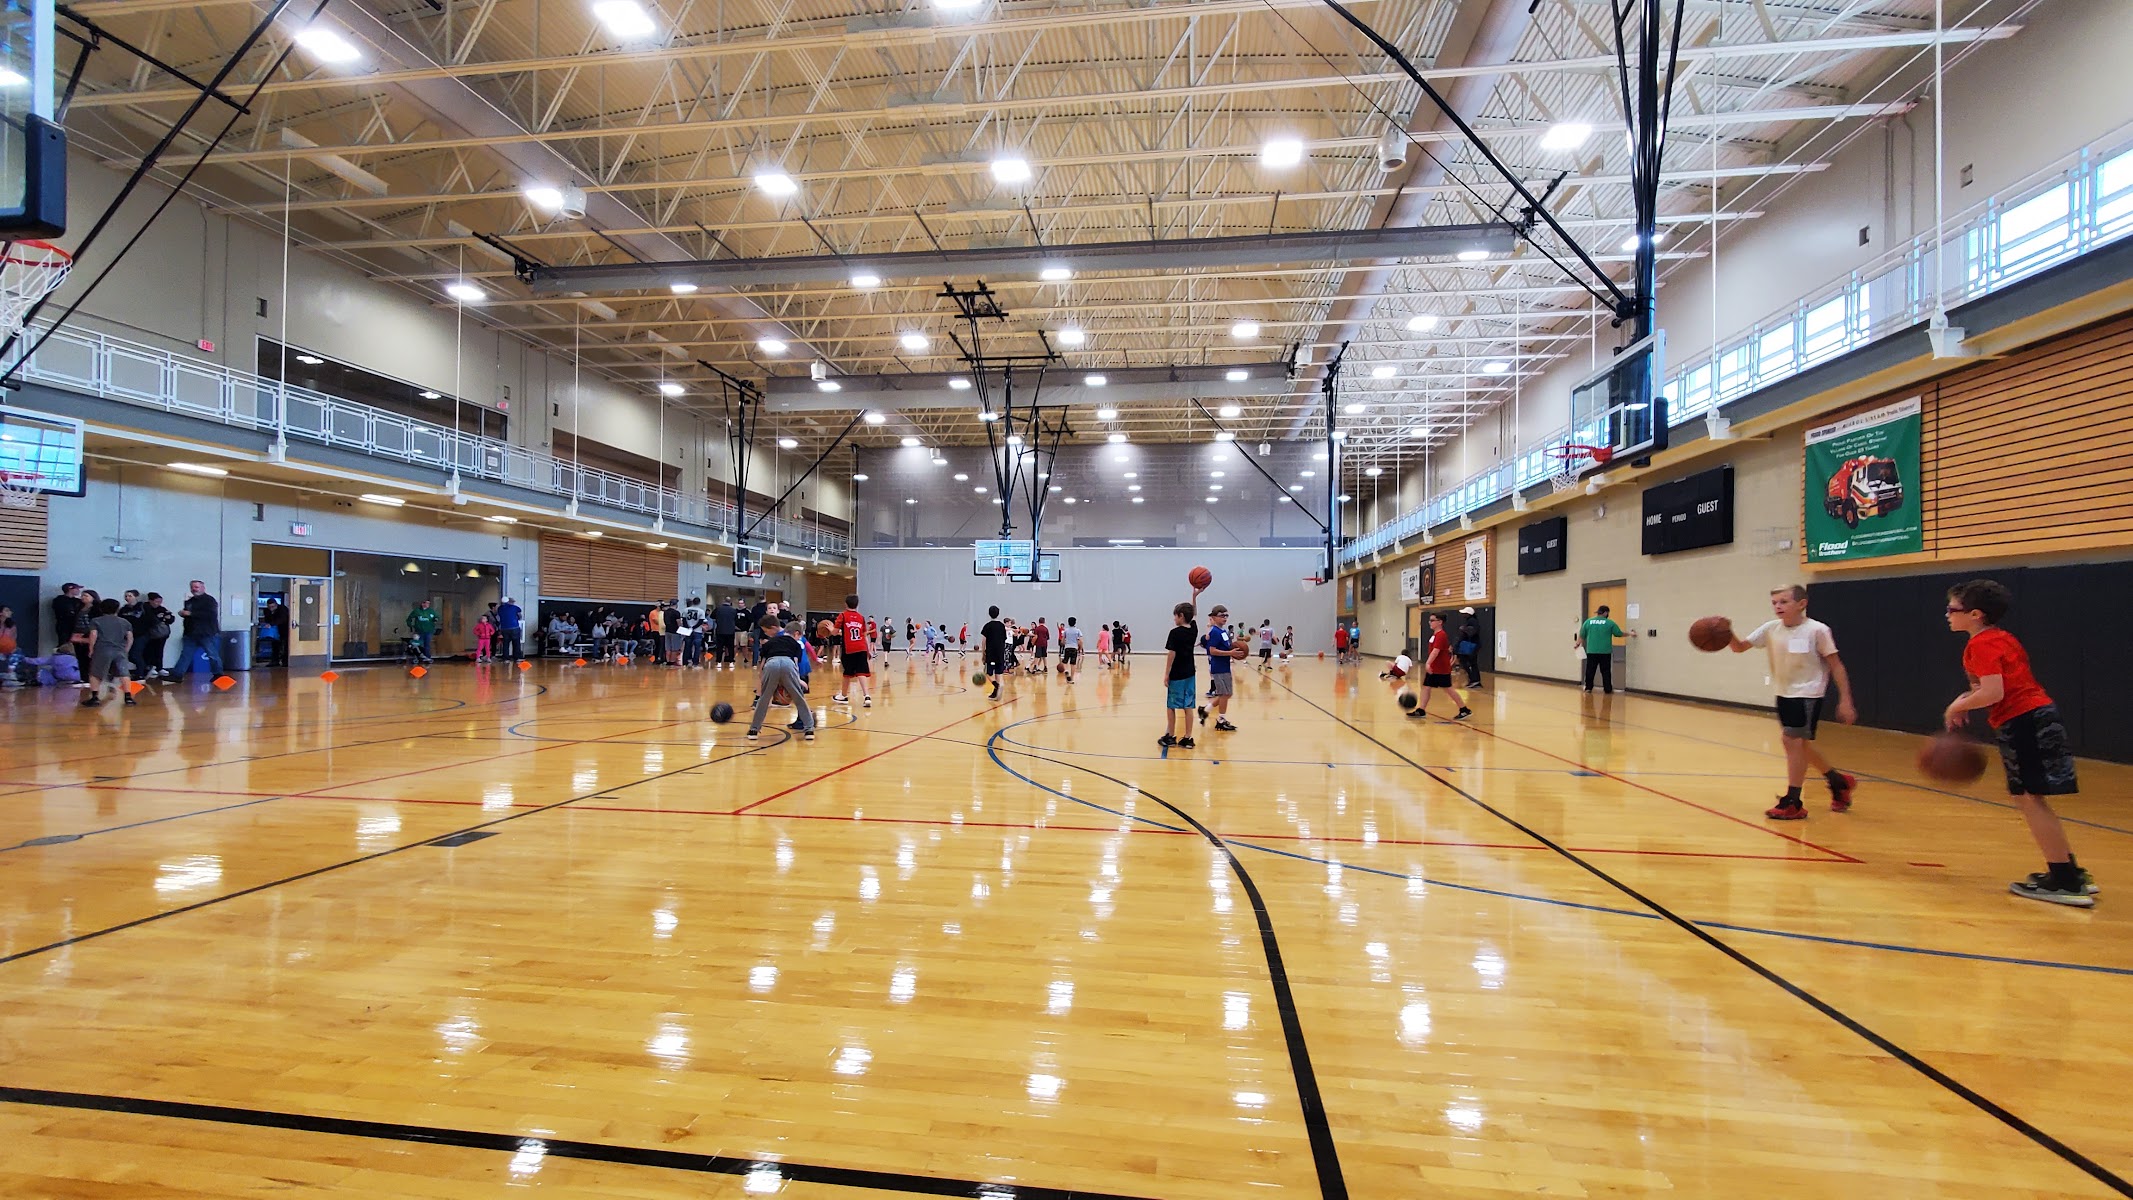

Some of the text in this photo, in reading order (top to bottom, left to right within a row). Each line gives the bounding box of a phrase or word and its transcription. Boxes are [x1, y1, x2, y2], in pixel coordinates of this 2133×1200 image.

[1646, 513, 1662, 526] HOME
[1697, 500, 1719, 515] GUEST
[1819, 540, 1848, 551] Flood
[687, 610, 698, 620] 34
[850, 627, 862, 641] 11
